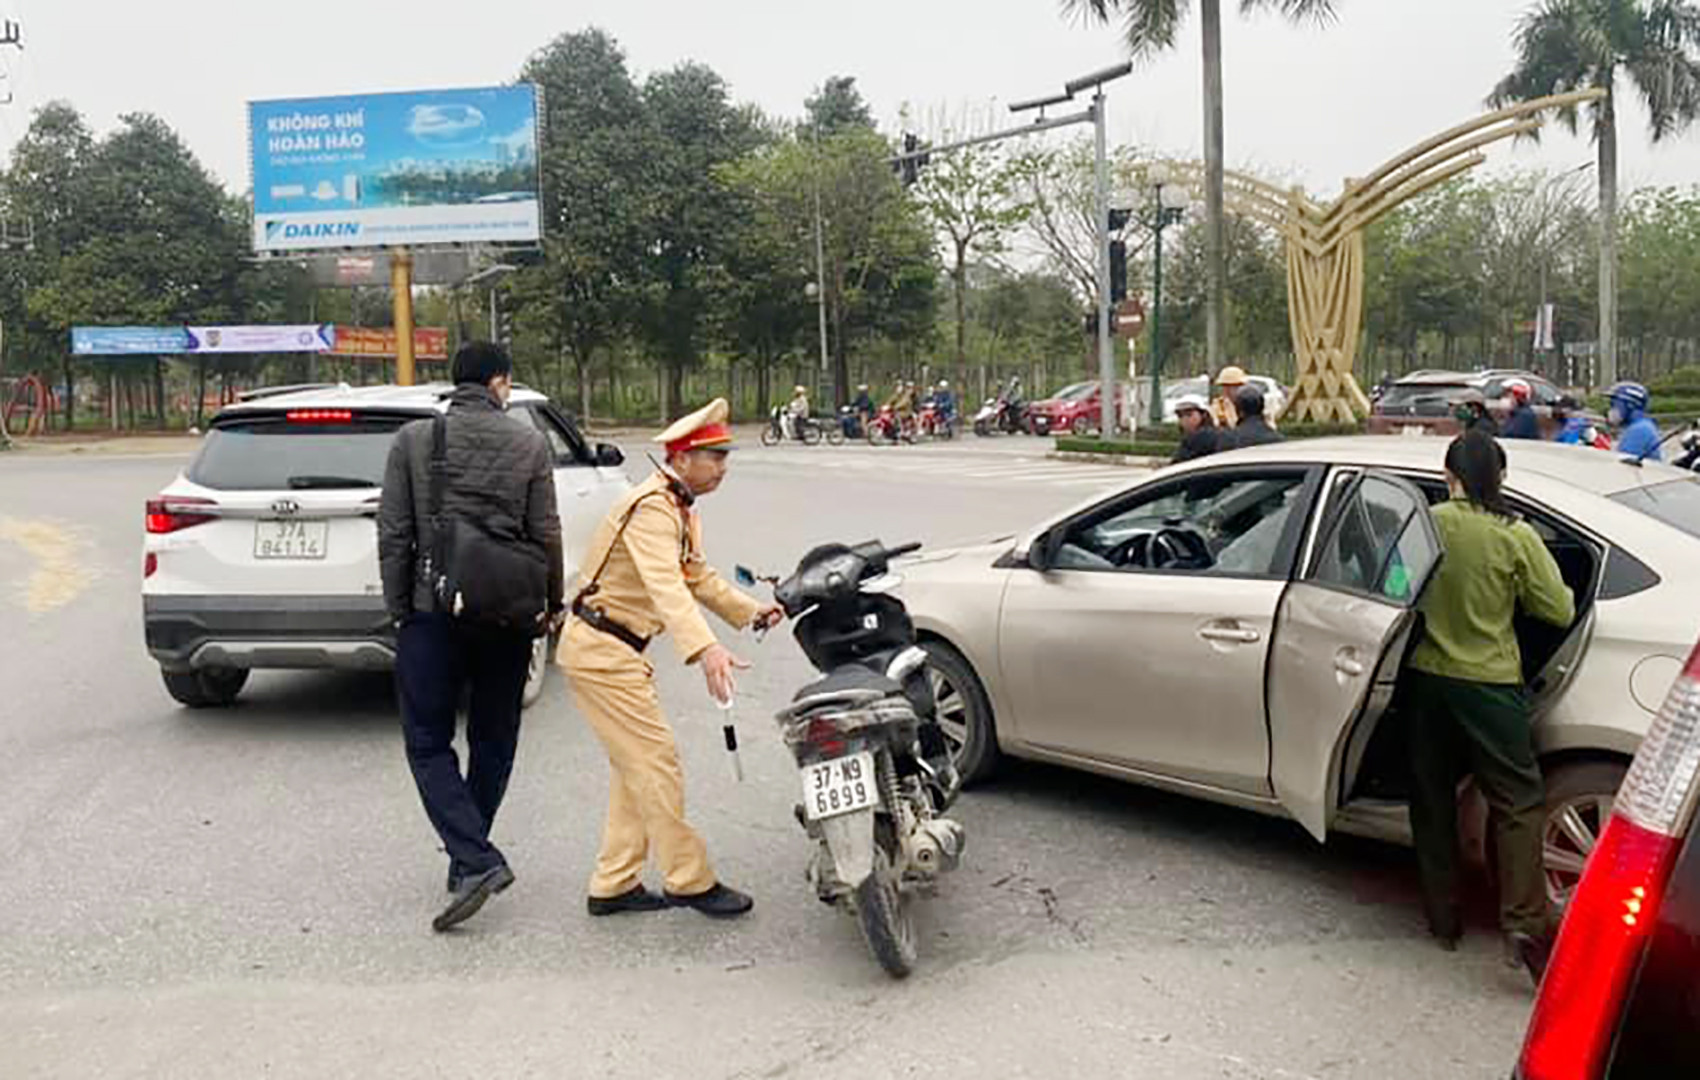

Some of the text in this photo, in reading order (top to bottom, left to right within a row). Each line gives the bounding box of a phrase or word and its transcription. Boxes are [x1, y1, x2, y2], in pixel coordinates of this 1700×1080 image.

[285, 222, 360, 238] DAIKIN
[276, 520, 306, 538] 37A
[816, 782, 867, 813] 6899
